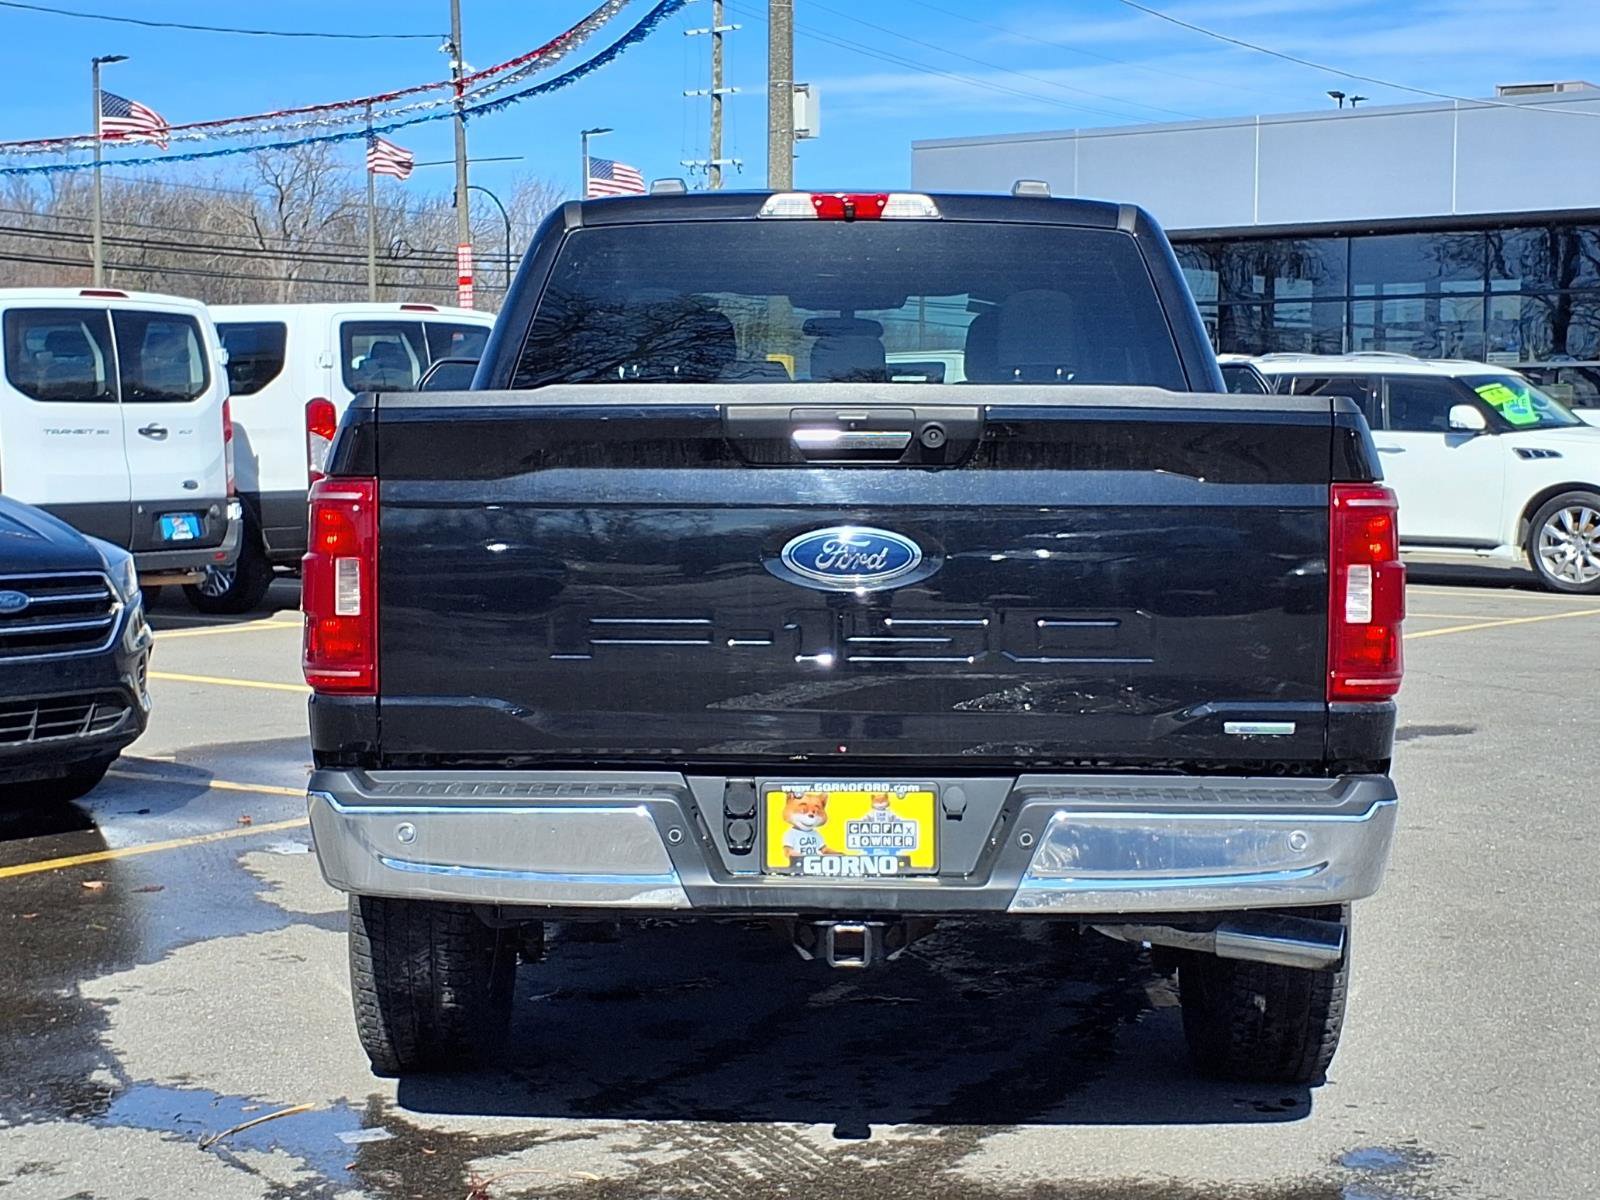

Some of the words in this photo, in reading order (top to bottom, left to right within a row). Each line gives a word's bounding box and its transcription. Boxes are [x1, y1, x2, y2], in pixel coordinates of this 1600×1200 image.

[815, 538, 889, 570] Ford
[549, 607, 1157, 664] F-150
[781, 783, 920, 793] www.GORNOFORD.com
[849, 823, 913, 835] CARFAX
[799, 837, 817, 846] CAR
[860, 836, 914, 847] OWNER
[800, 847, 818, 856] FOX
[803, 856, 898, 875] GORNO
